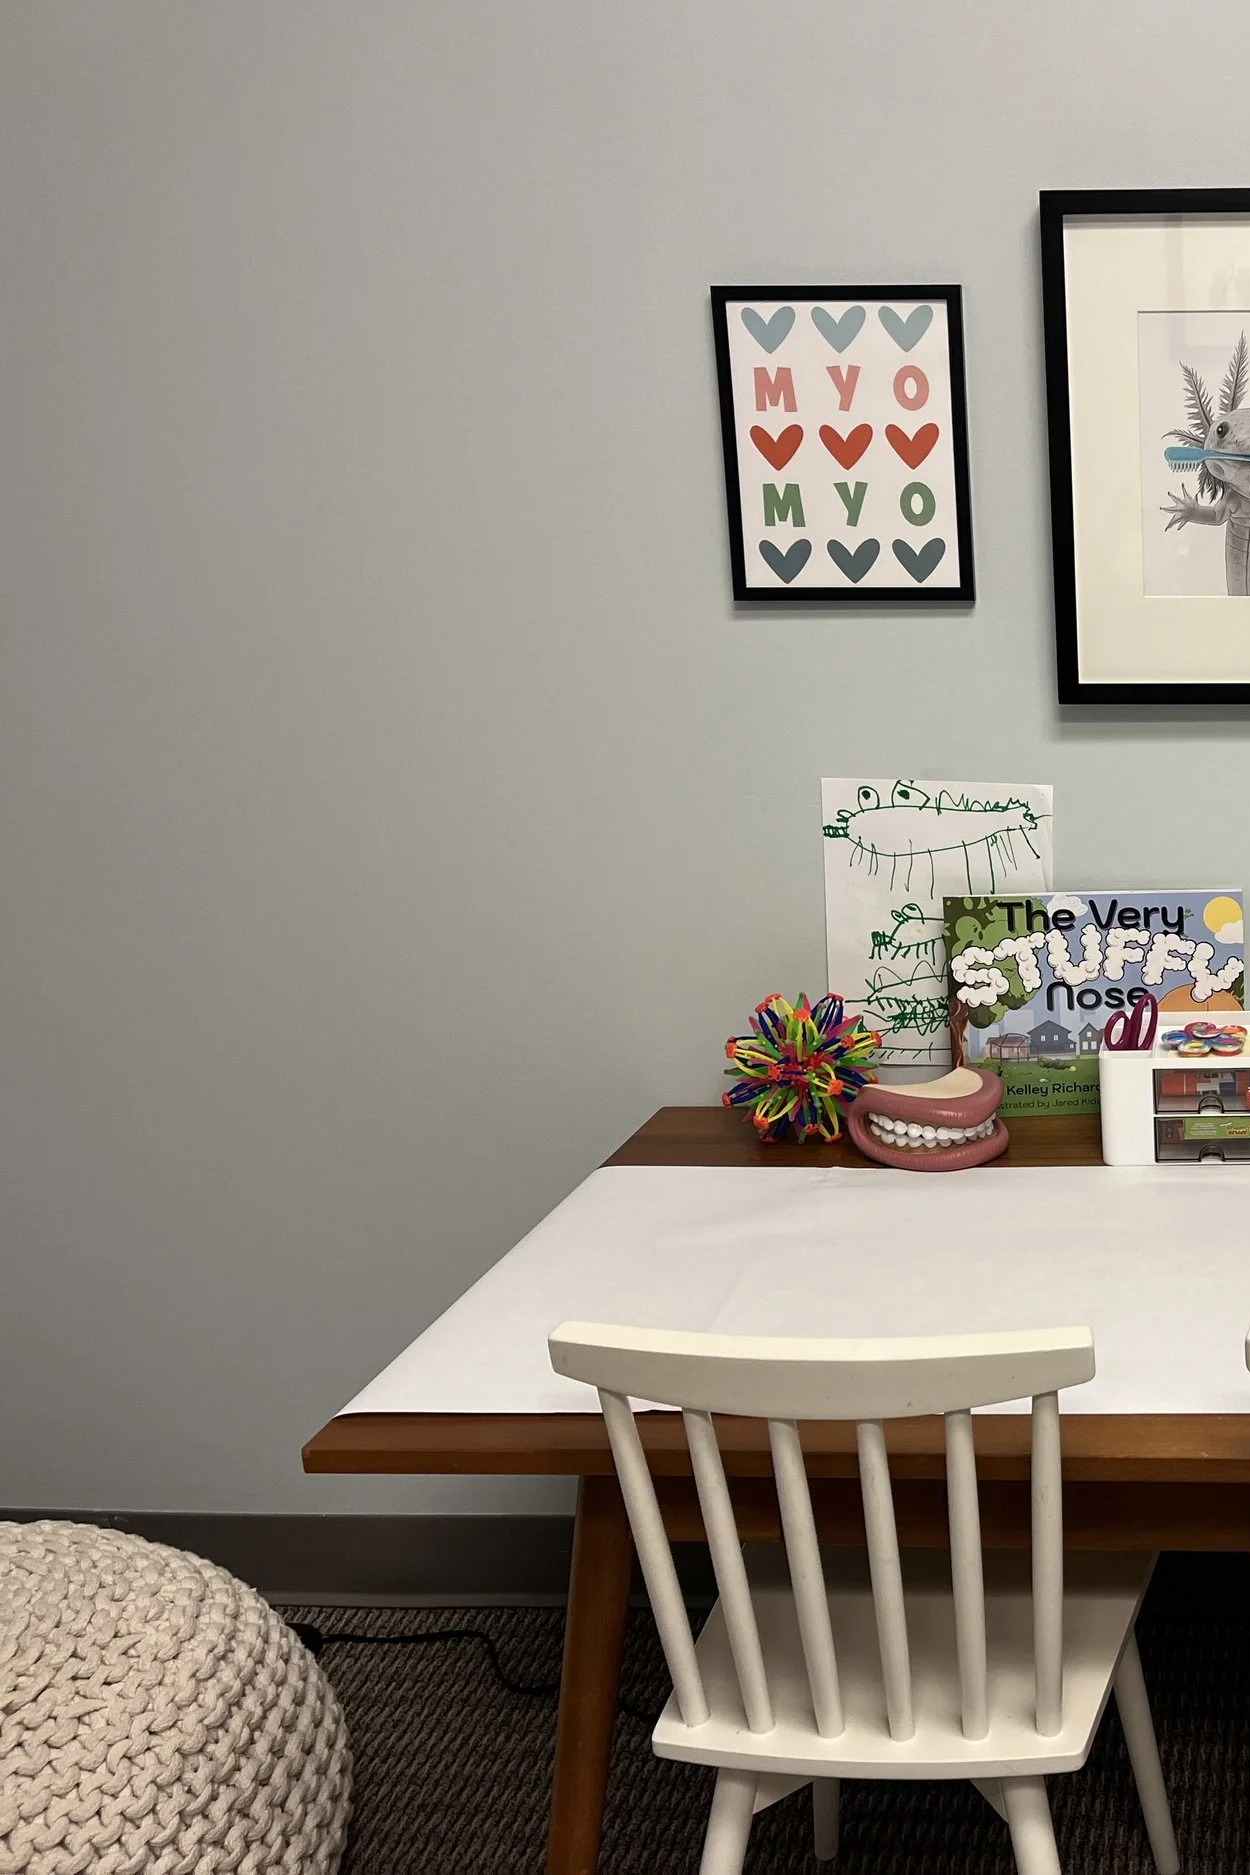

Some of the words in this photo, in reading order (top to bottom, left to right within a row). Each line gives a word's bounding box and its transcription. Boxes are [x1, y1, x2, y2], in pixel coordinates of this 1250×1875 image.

[998, 899, 1076, 932] The
[1089, 899, 1184, 935] Very
[950, 923, 1245, 1008] STUFFY
[1007, 1084, 1048, 1097] Kelley
[1037, 1100, 1050, 1109] by
[1052, 1099, 1079, 1107] Jared
